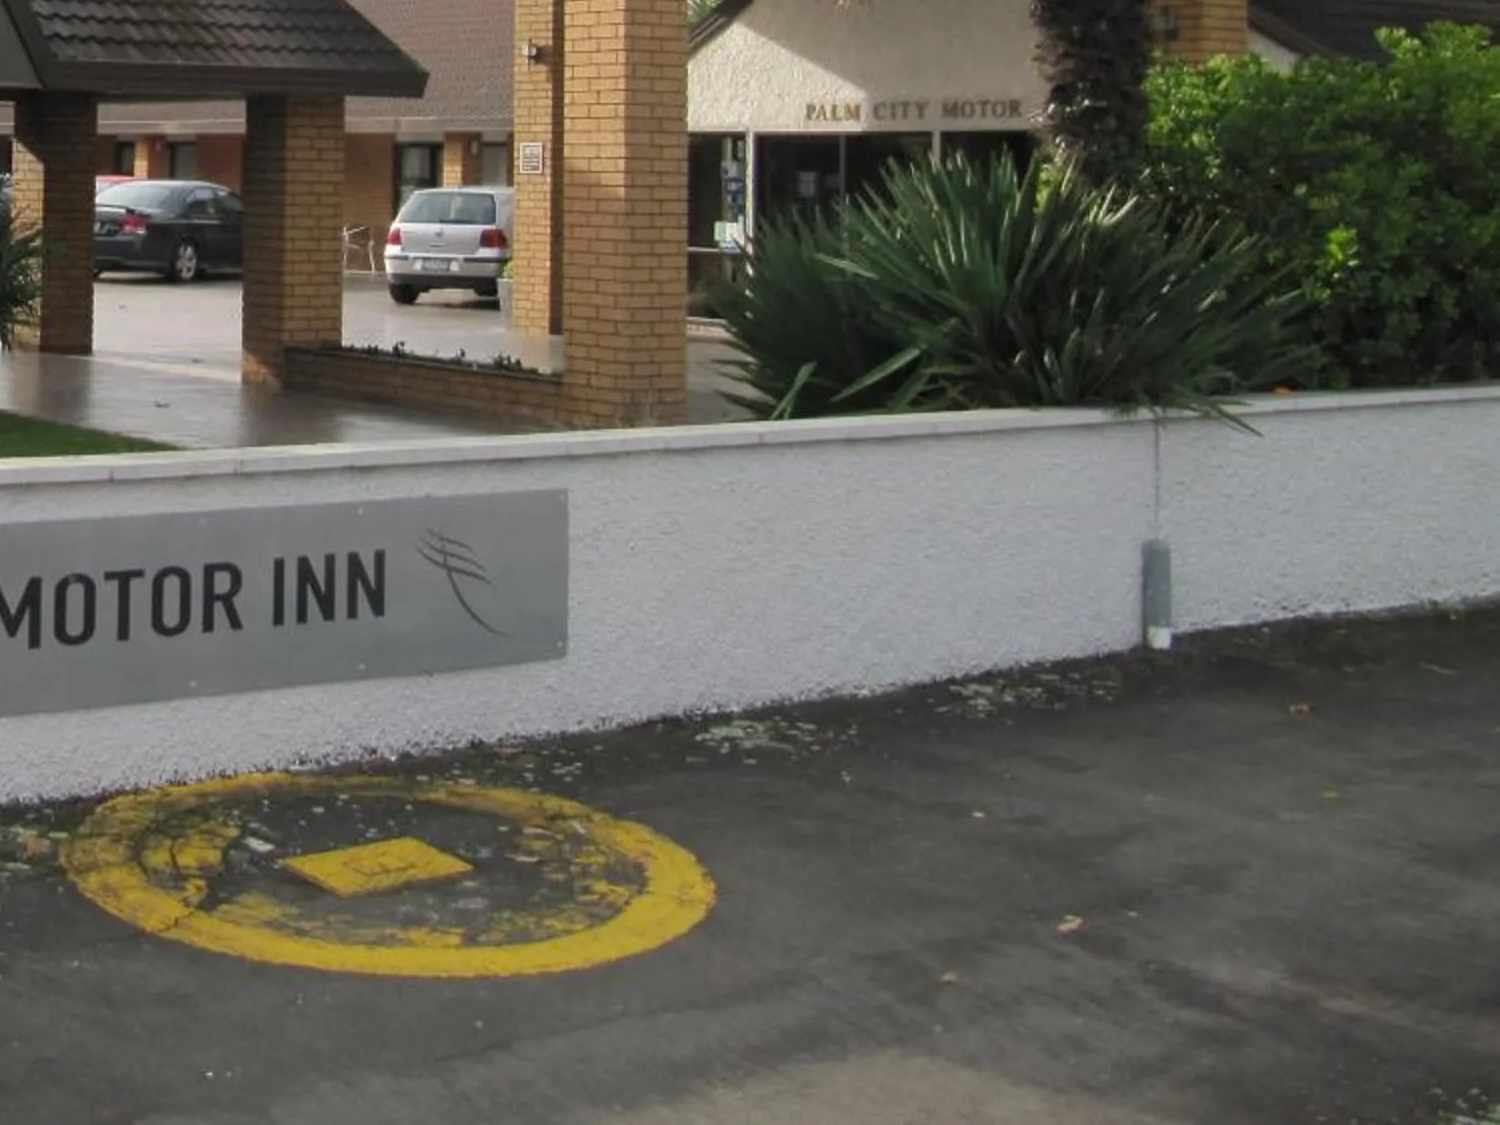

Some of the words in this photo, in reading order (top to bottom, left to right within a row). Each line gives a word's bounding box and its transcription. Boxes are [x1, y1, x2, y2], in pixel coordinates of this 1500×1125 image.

[805, 102, 861, 122] PALM
[872, 100, 929, 121] CITY
[941, 99, 1023, 120] MOTOR
[271, 548, 387, 627] INN
